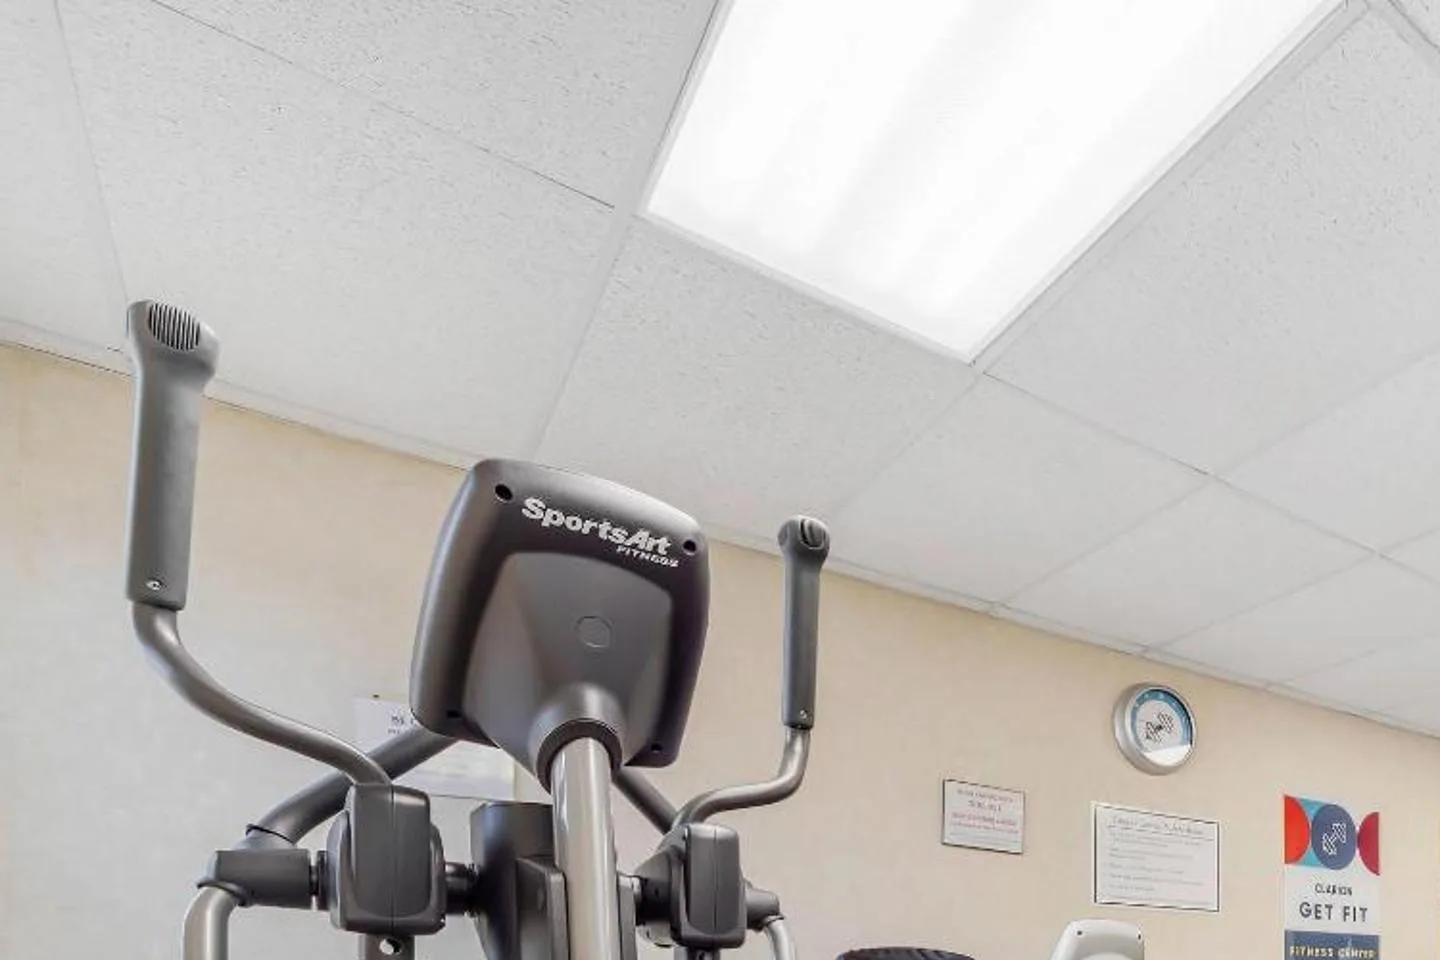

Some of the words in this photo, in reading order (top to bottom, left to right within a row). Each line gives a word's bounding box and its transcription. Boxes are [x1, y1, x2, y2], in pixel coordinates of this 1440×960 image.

[521, 497, 671, 555] SportsArt
[1299, 901, 1333, 920] GET
[1343, 905, 1368, 922] FIT
[1289, 945, 1334, 957] FITNESS
